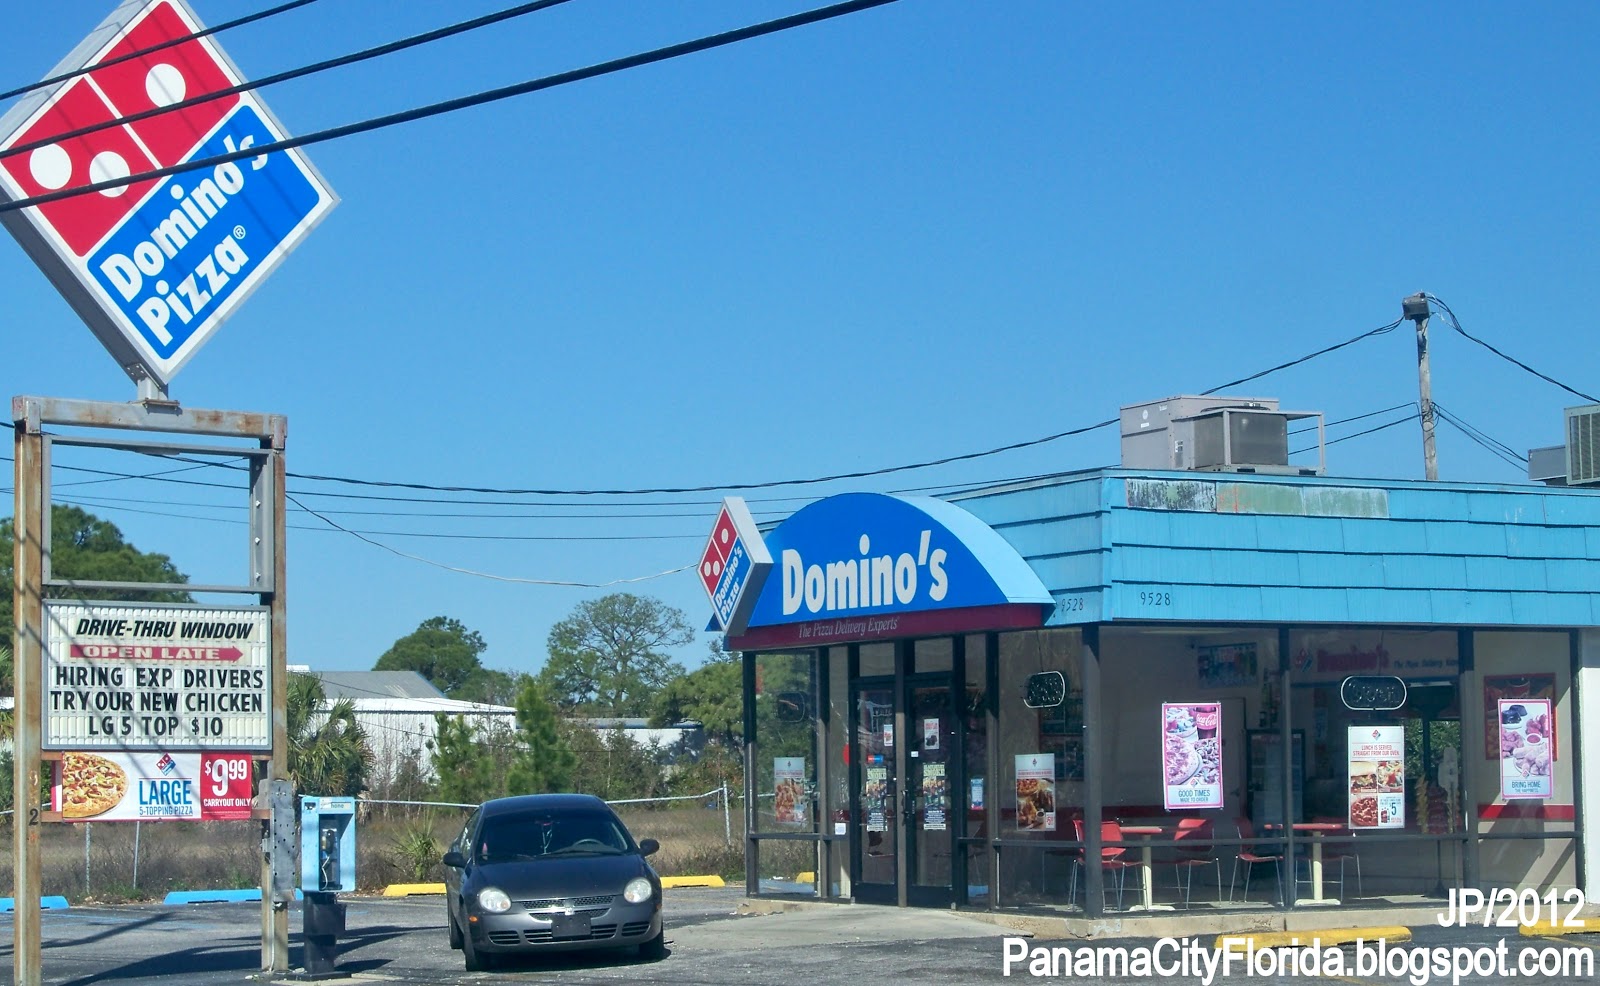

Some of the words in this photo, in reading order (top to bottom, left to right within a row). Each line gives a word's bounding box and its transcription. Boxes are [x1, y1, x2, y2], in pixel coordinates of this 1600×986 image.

[100, 134, 268, 302] Domino's
[715, 546, 743, 609] Domino's
[782, 530, 947, 615] Domino's
[1061, 598, 1084, 612] 9528
[1141, 592, 1171, 606] 9528
[76, 618, 177, 637] DRIVE-THRU
[180, 621, 254, 639] WINDOW
[799, 624, 811, 638] The
[813, 622, 833, 637] Pizza
[835, 620, 866, 636] Delivery
[83, 646, 152, 659] OPEN
[161, 647, 220, 660] LATE
[56, 666, 123, 686] HIRING
[136, 667, 173, 687] EXP
[184, 669, 263, 688] DRIVERS
[51, 691, 90, 710] TRY
[95, 692, 133, 711] OUR
[140, 692, 178, 712] NEW
[185, 692, 262, 712] CHICKEN
[89, 716, 114, 735] LG
[121, 716, 131, 735] 5
[142, 716, 179, 736] TOP
[191, 717, 223, 736] $10
[139, 780, 192, 805] LARGE
[204, 798, 235, 807] CARRYOUT
[236, 798, 251, 807] ONLY
[139, 806, 173, 815] 5-TOPPING
[174, 805, 193, 815] PIZZA
